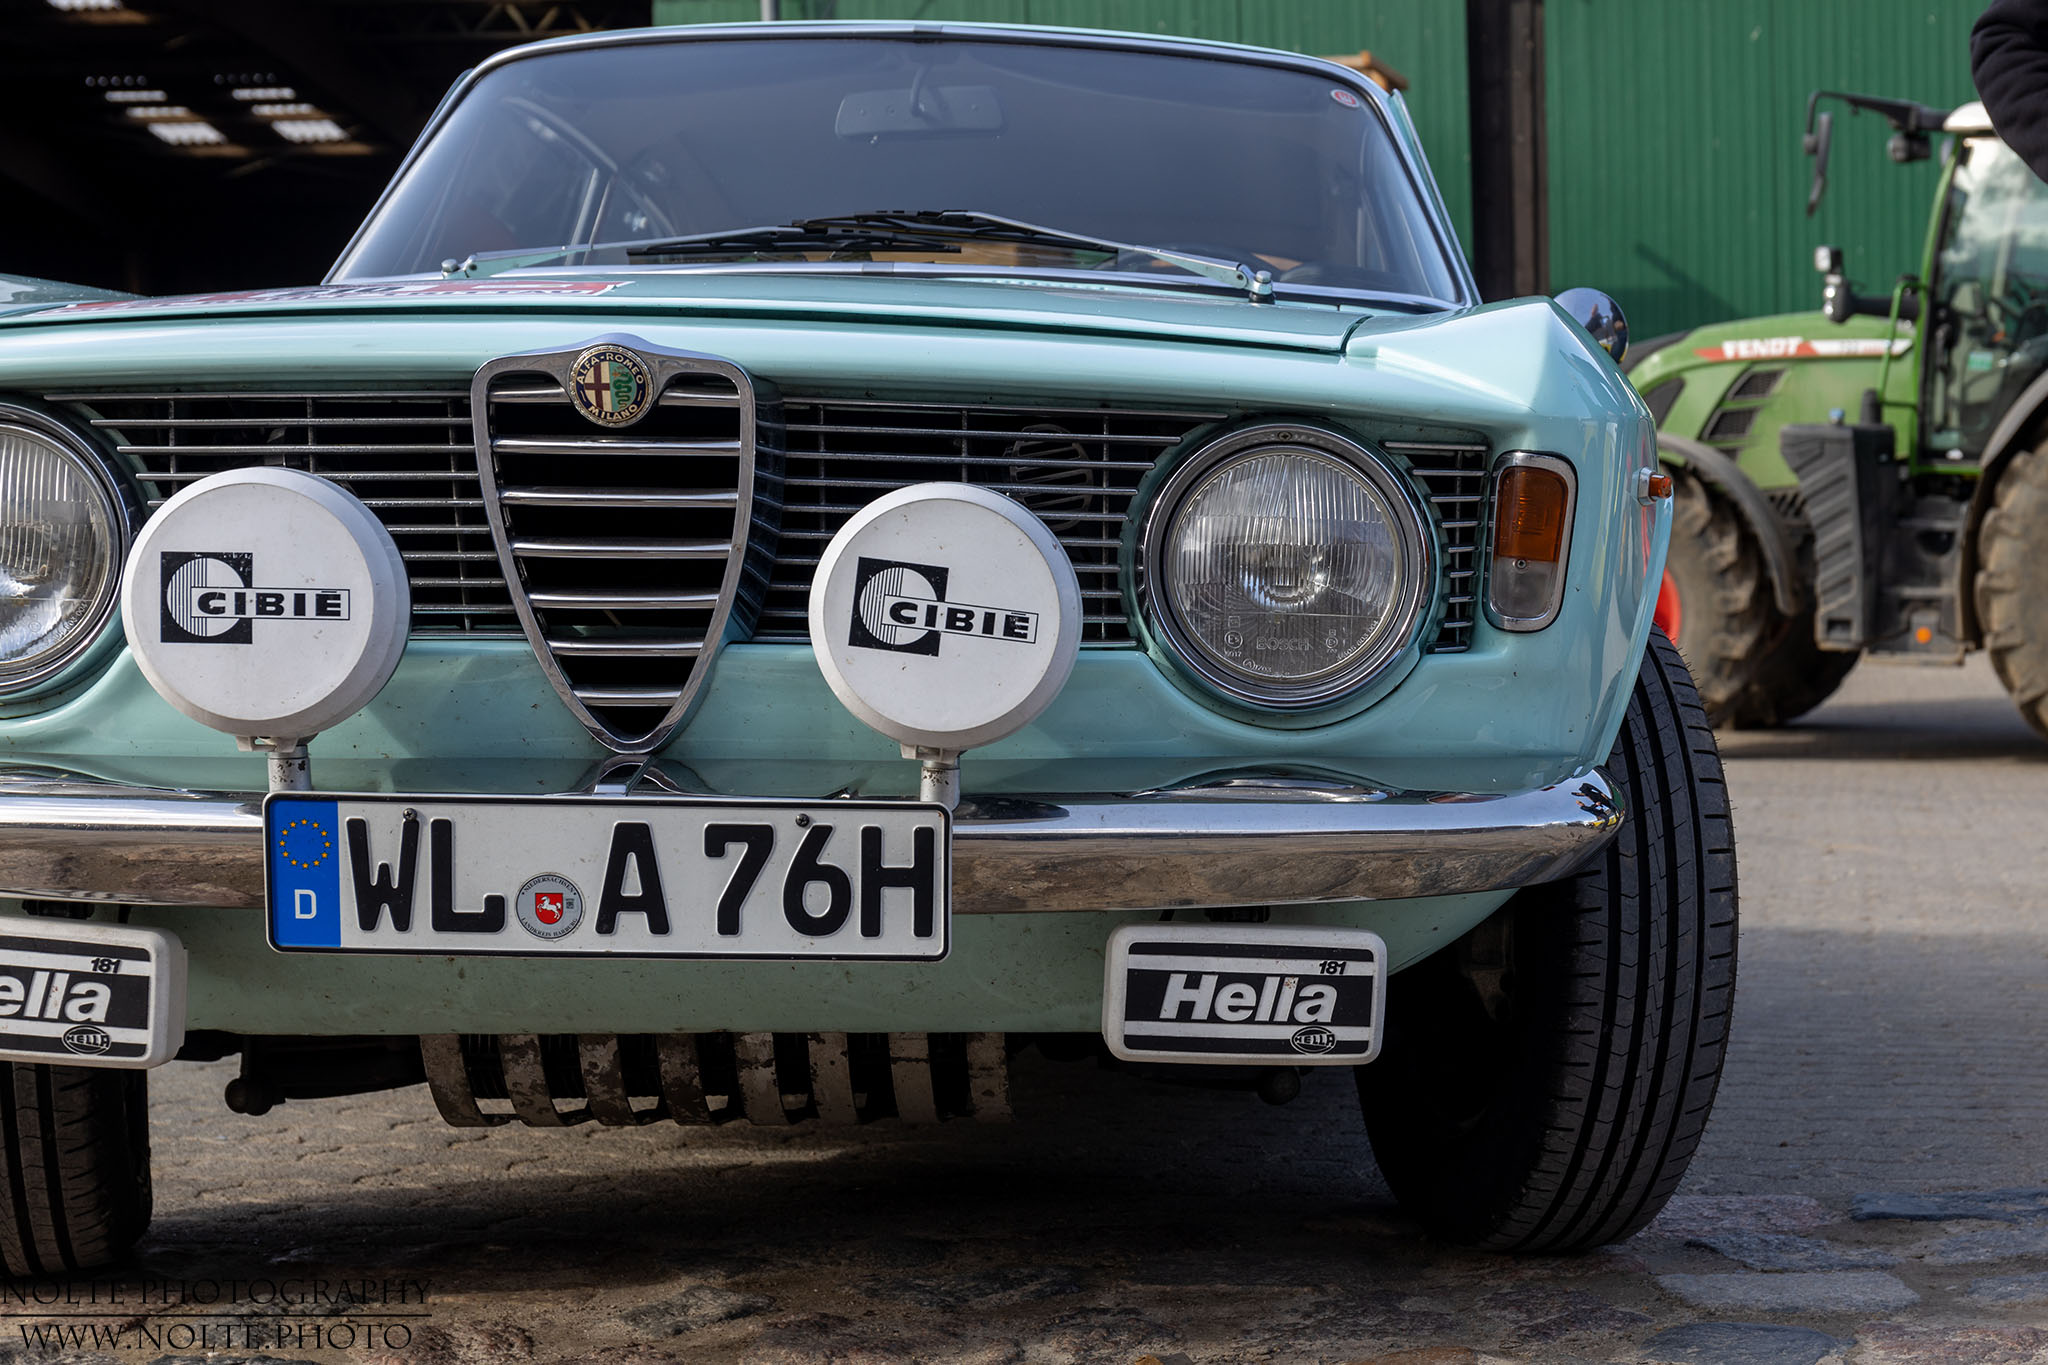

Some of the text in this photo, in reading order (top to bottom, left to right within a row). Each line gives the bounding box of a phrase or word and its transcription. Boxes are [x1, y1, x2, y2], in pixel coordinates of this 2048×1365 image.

[1721, 336, 1803, 360] FENDT
[576, 352, 644, 385] ALFA-ROMEO
[588, 403, 638, 420] MILANO
[1256, 636, 1309, 651] BOSCH
[345, 817, 936, 939] WL A 76H
[294, 888, 317, 920] D
[90, 957, 122, 974] 181
[1318, 960, 1347, 975] 181
[0, 970, 112, 1023] ella
[1159, 973, 1338, 1024] Hella
[66, 1034, 111, 1050] HELLA
[1295, 1031, 1336, 1047] HELLA
